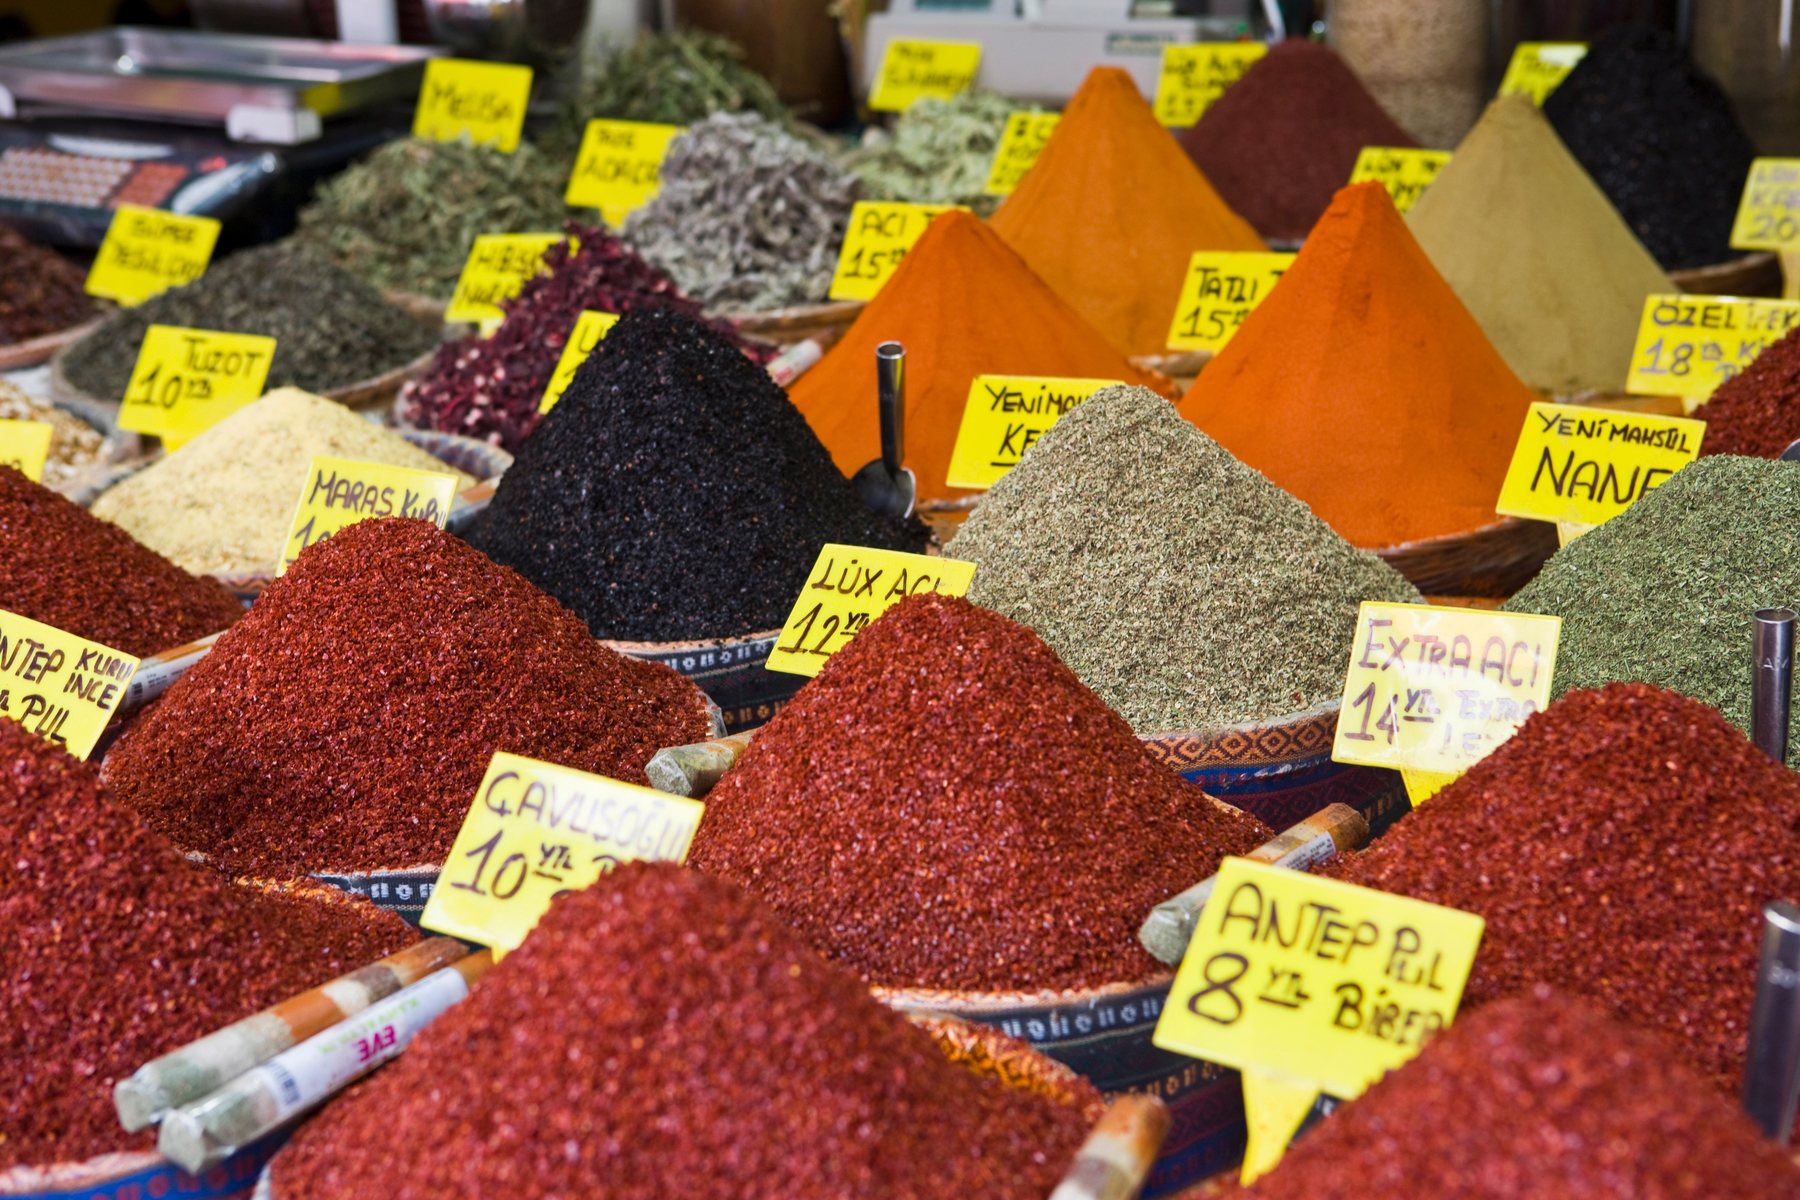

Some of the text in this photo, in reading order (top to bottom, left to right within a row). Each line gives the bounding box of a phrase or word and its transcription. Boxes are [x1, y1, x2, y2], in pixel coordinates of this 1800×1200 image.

[842, 248, 888, 279] 15
[1178, 305, 1230, 341] 15
[1638, 337, 1695, 377] 18
[128, 362, 183, 409] 10
[0, 625, 65, 684] NTEP
[777, 602, 841, 656] 12
[1343, 681, 1401, 745] 14
[449, 829, 529, 901] 10
[1218, 881, 1380, 964] ANTEP
[1186, 951, 1251, 1026] 8
